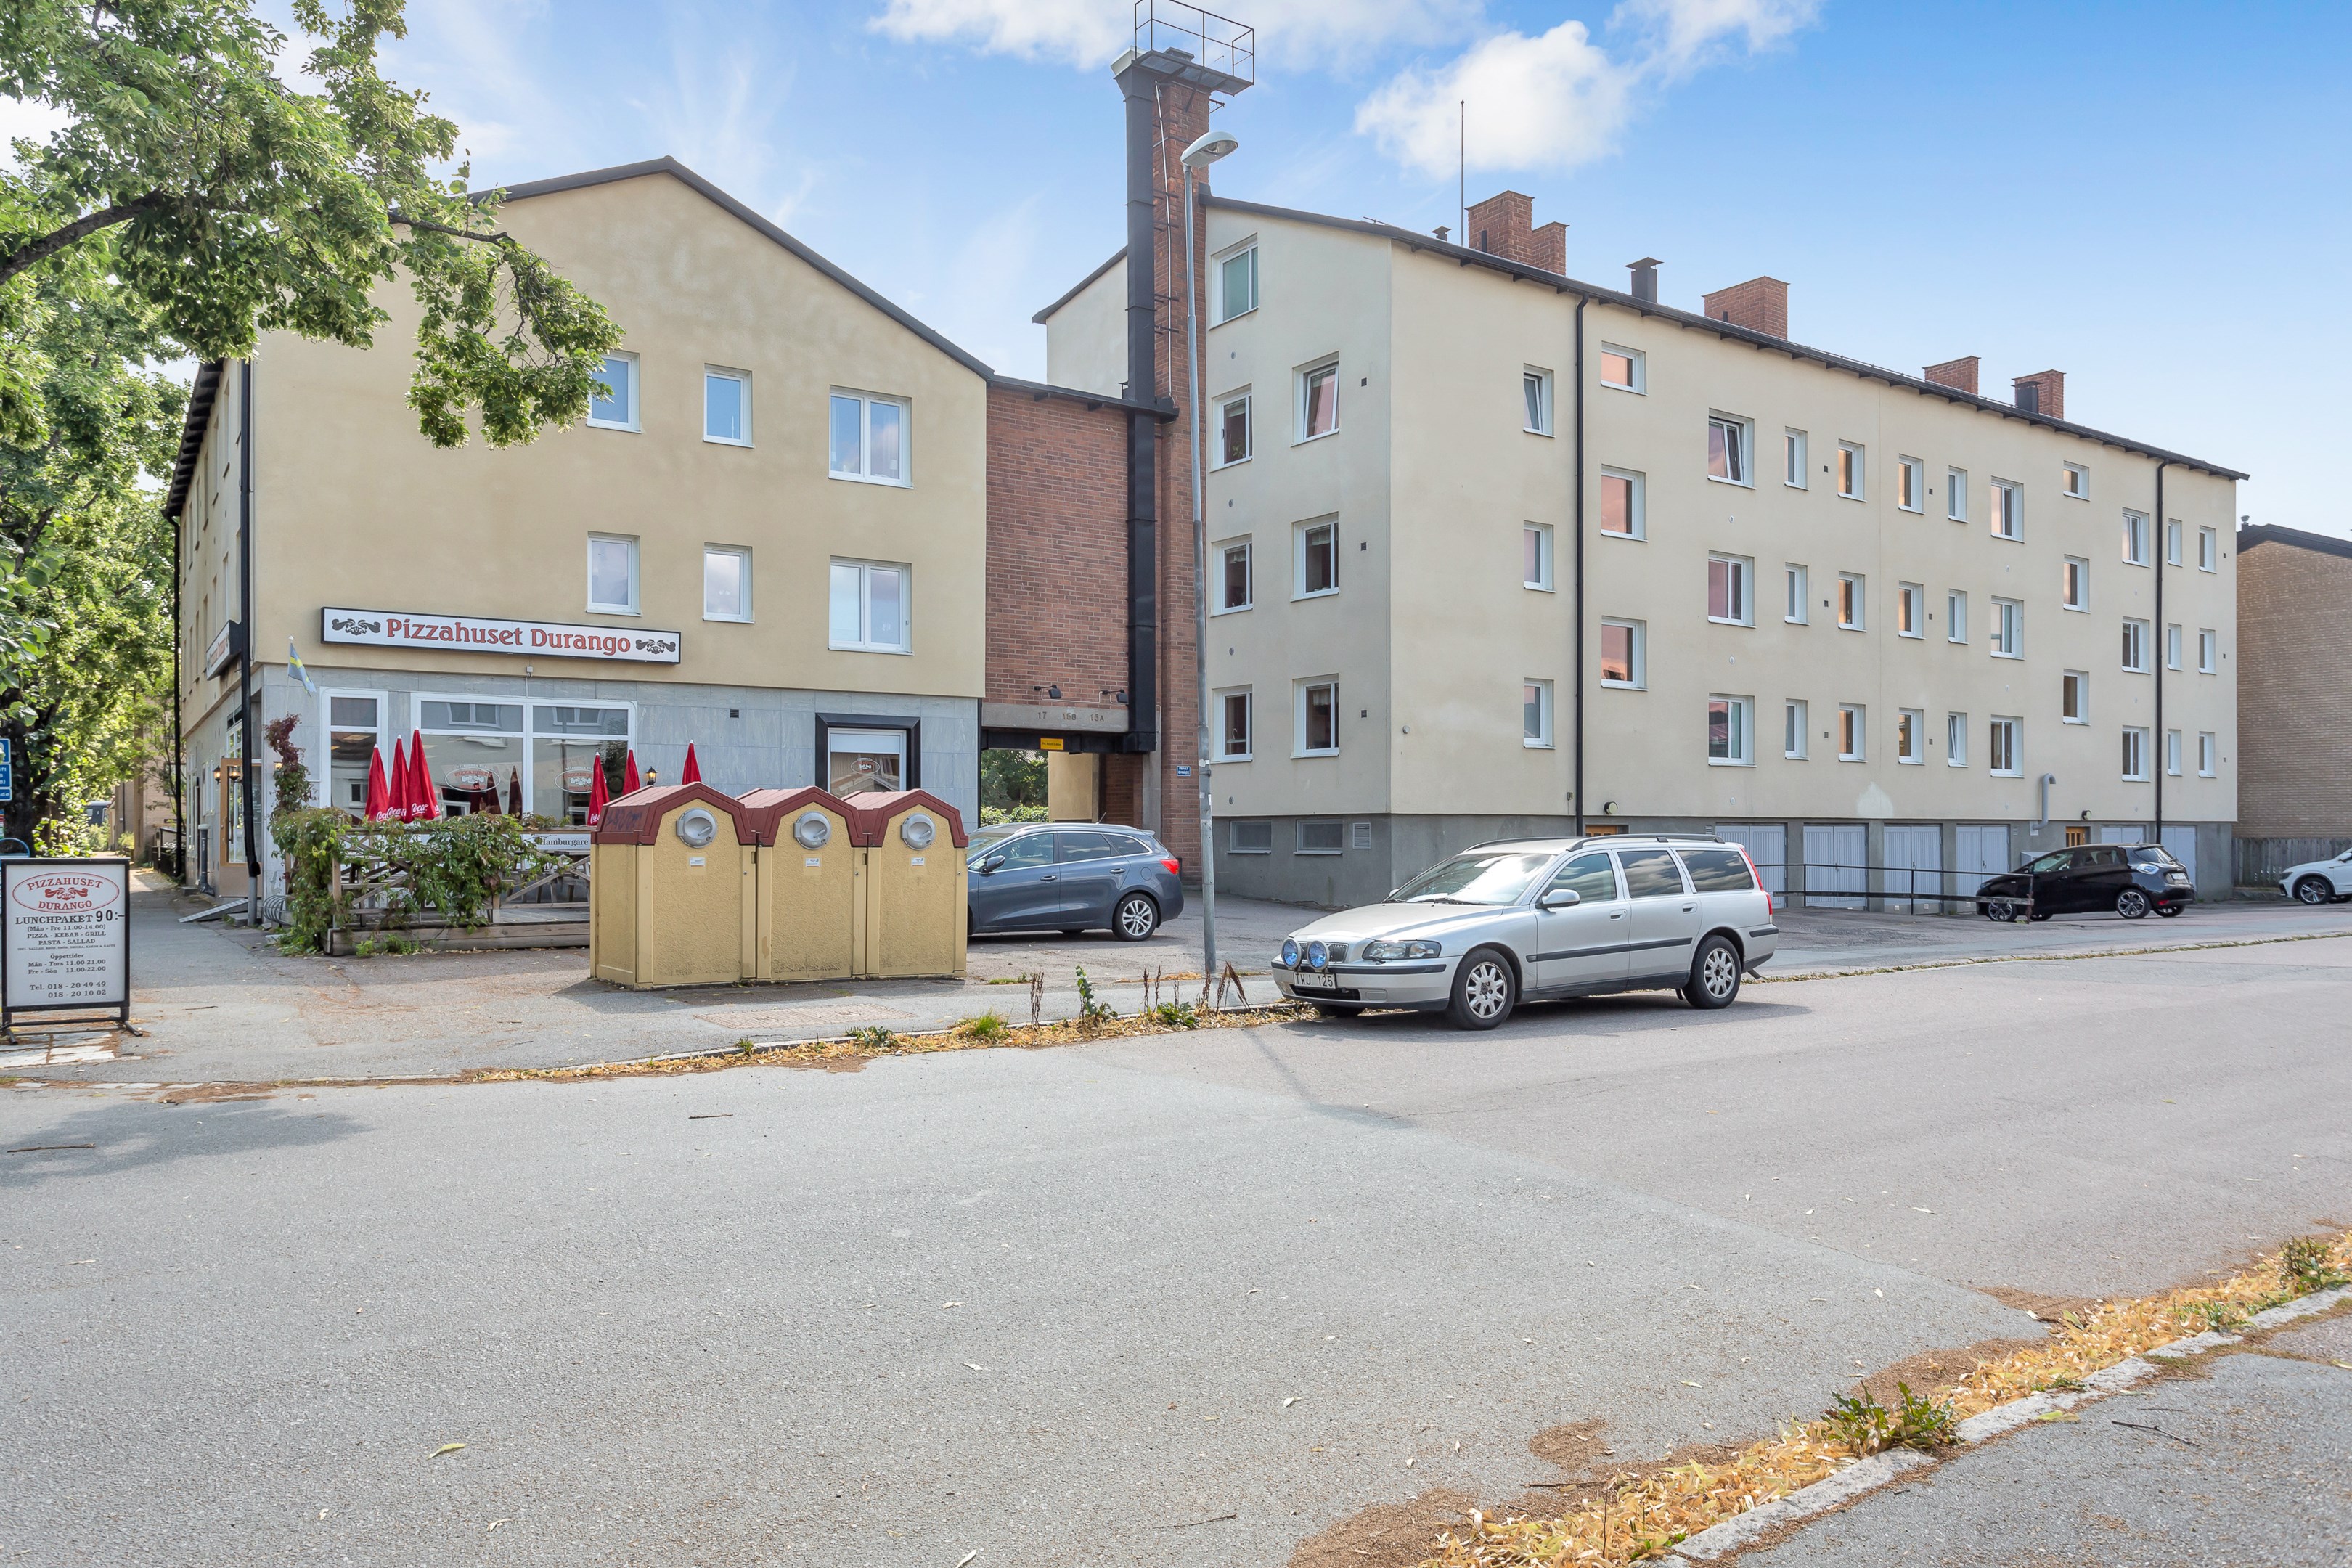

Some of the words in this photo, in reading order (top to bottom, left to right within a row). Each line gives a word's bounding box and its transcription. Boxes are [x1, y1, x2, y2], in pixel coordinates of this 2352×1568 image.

[386, 618, 523, 645] Pizzahuset
[531, 629, 631, 656] Durango
[27, 877, 103, 891] PIZZAHUSET
[38, 900, 92, 910] DURANGO
[15, 915, 94, 925] LUNCHPAKET
[1295, 973, 1311, 985] TWJ
[1318, 975, 1333, 987] 125
